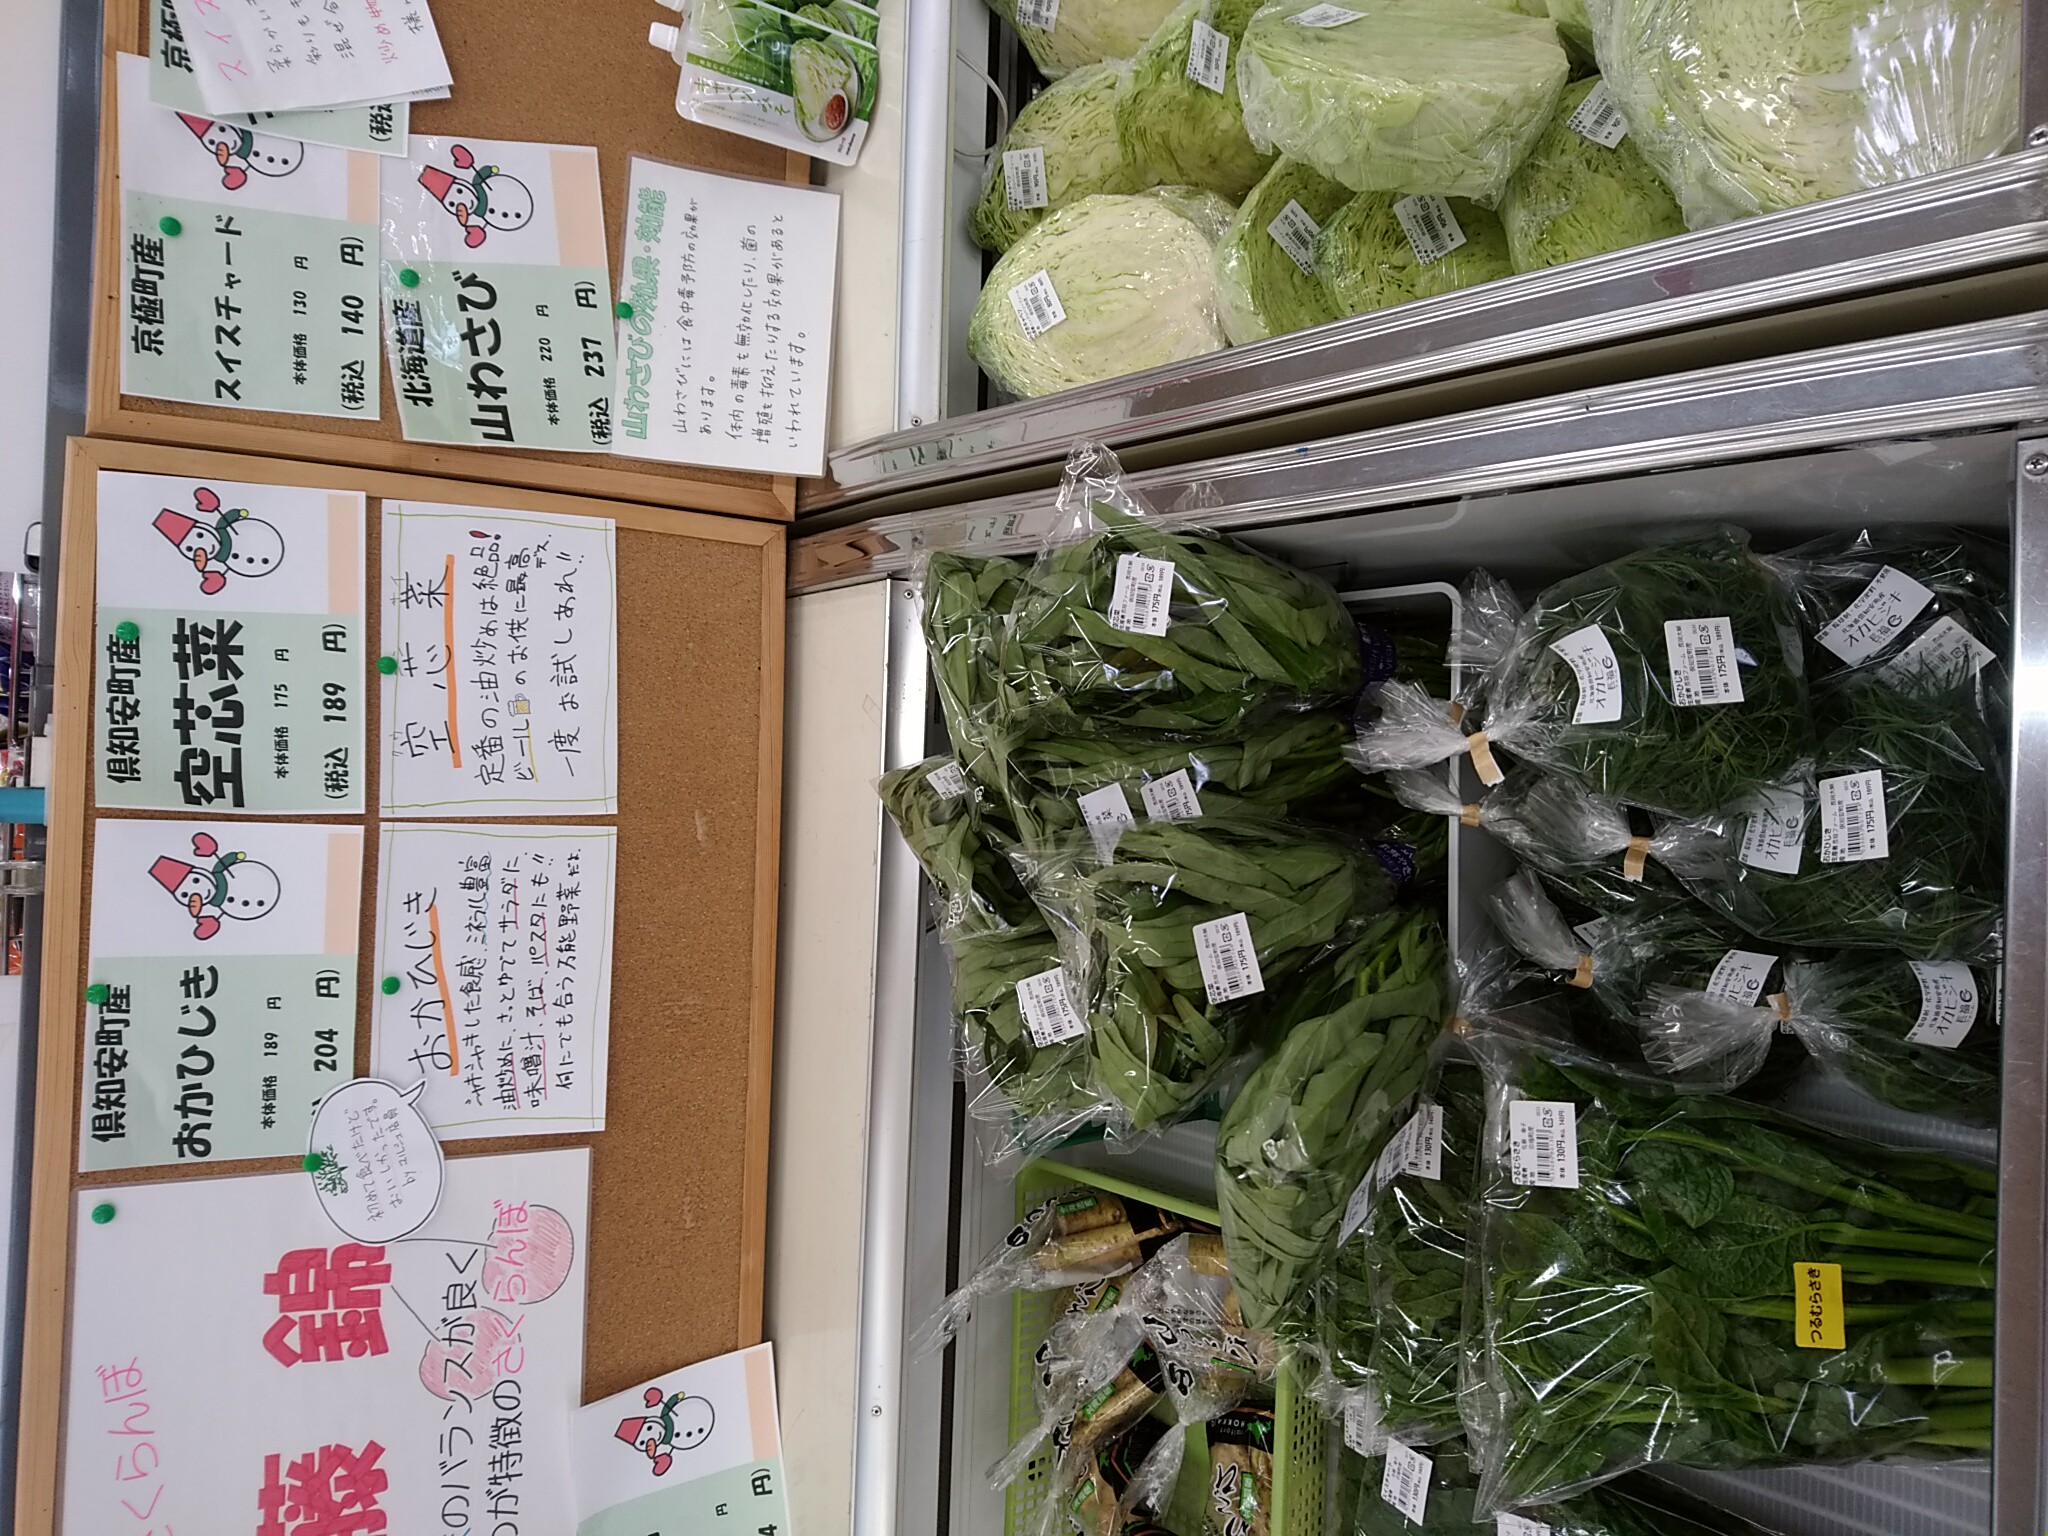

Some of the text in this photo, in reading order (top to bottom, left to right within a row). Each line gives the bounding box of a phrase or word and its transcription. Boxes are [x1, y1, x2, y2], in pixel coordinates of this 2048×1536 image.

[130, 232, 166, 357] 京極町産
[213, 214, 243, 402] スイスチャード
[292, 256, 309, 386] 本体価格 130 円
[340, 236, 366, 411] (税込 140 円)
[620, 187, 667, 440] 山わさびの効果・効能
[390, 298, 434, 408] 北海道産
[451, 270, 515, 443] 山わさび
[535, 303, 560, 426] 本体価格 220 円
[574, 280, 612, 446] (税込 237 円)
[786, 329, 808, 448] いわれています。
[698, 373, 716, 436] あります。
[1151, 593, 1161, 612] 175円
[1843, 590, 1901, 647] オカヒジキ
[400, 565, 455, 758] 空芯菜
[1581, 645, 1606, 709] オカヒジキ
[1715, 655, 1727, 677] 175円
[172, 618, 245, 808] 空芯菜
[274, 648, 290, 779] 本体価格 175 円
[322, 623, 350, 800] (税込 189 円)
[512, 719, 535, 781] ビール
[1865, 810, 1875, 832] 175円
[314, 968, 341, 999] 円)
[402, 887, 454, 1075] おかひじき
[1237, 949, 1248, 970] 175円
[1933, 975, 1958, 1035] オカヒジキ
[313, 1027, 339, 1072] 204
[1058, 997, 1070, 1016] 175円
[171, 964, 219, 1158] おかひじき
[260, 996, 281, 1130] 本体価格 189 円
[402, 1171, 417, 1187] by
[1424, 1136, 1434, 1156] 130円
[1512, 1141, 1521, 1182] つるむらさき
[1556, 1140, 1566, 1161] 130円
[261, 1242, 393, 1368] 錦
[1807, 1267, 1823, 1342] つるむらさき
[440, 1247, 479, 1536] のバランスが良く
[715, 1503, 728, 1517] 円
[750, 1468, 772, 1497] 円)
